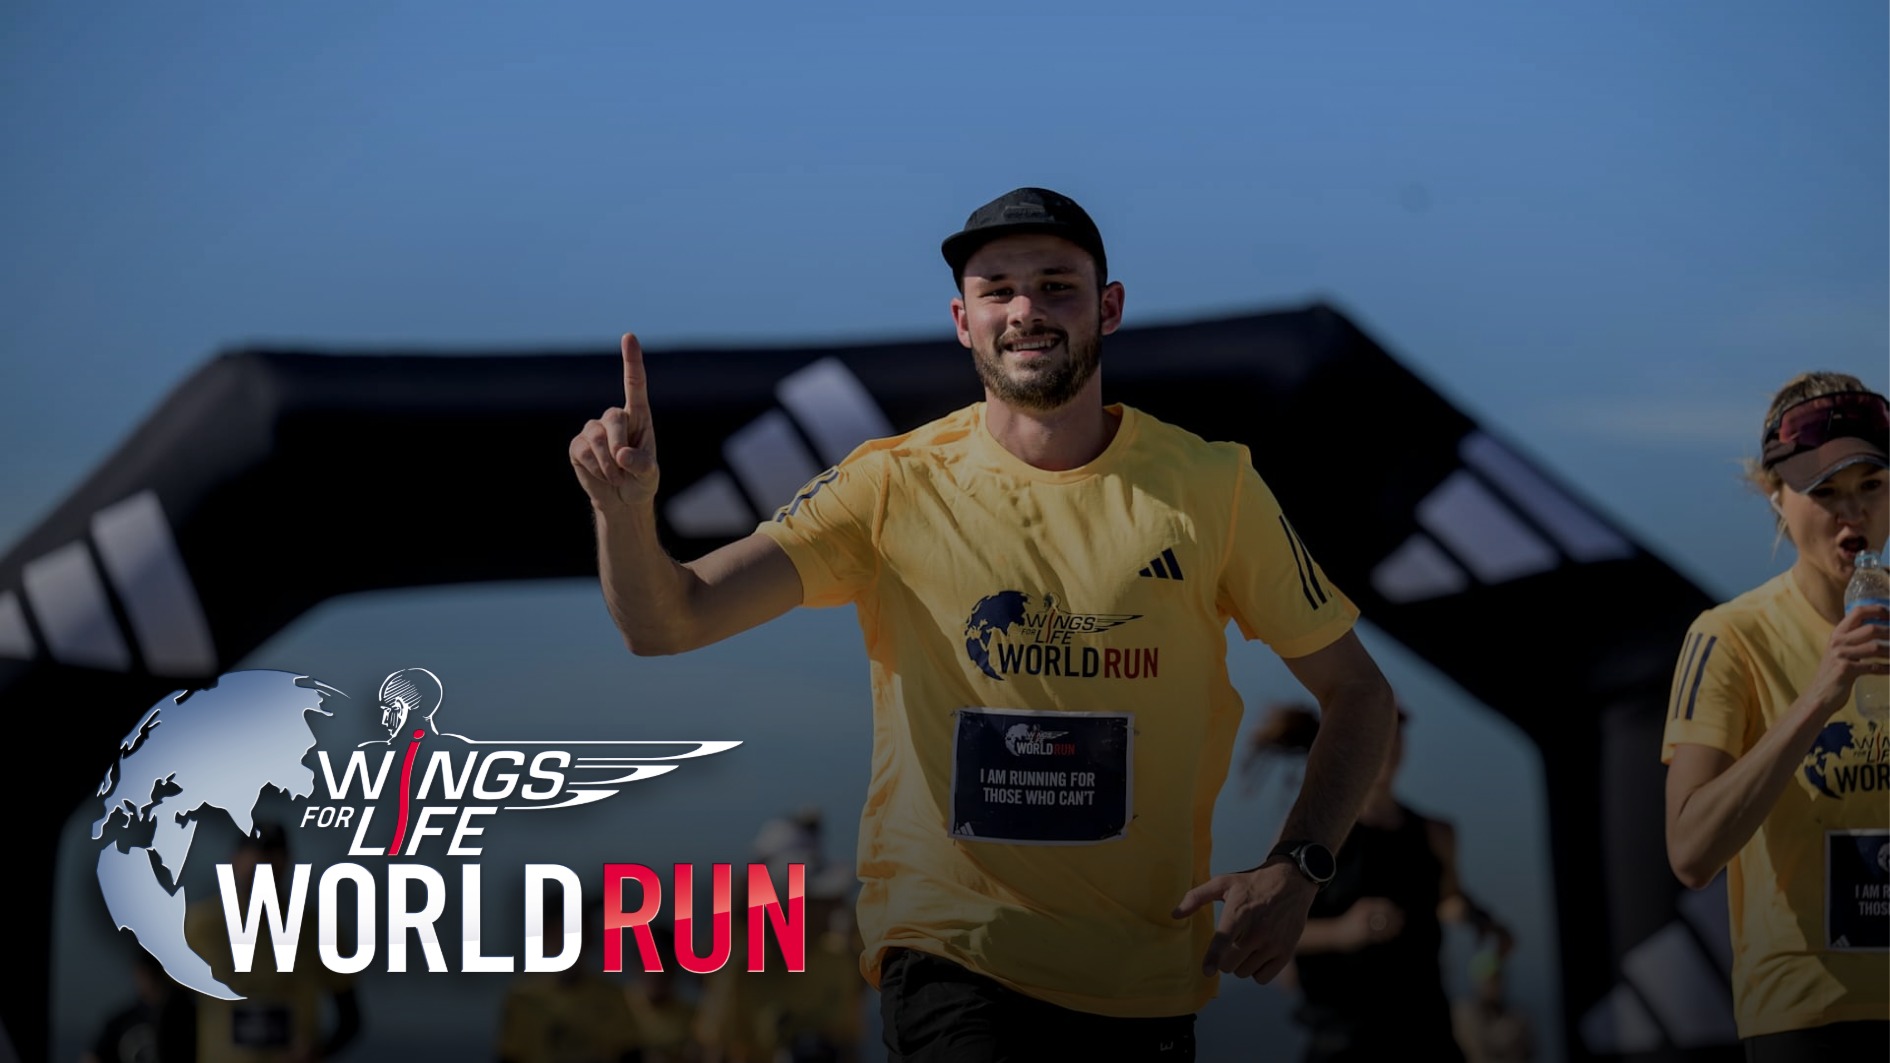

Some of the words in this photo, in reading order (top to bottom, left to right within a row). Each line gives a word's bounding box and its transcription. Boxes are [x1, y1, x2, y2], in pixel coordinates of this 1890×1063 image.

[1035, 629, 1075, 645] LIFE
[997, 643, 1099, 678] WORLD
[1104, 647, 1159, 679] RUN
[1016, 741, 1054, 756] WORLD
[1054, 743, 1075, 756] RUN
[980, 768, 985, 783] I
[987, 769, 1006, 784] AM
[1009, 770, 1067, 787] RUNNING
[1070, 772, 1095, 787] FOR
[983, 787, 1022, 804] THOSE
[1025, 789, 1055, 805] WHO
[1059, 790, 1095, 805] CAN'T
[1855, 883, 1860, 899] I
[1862, 883, 1880, 899] AM
[1857, 900, 1890, 917] THOS
